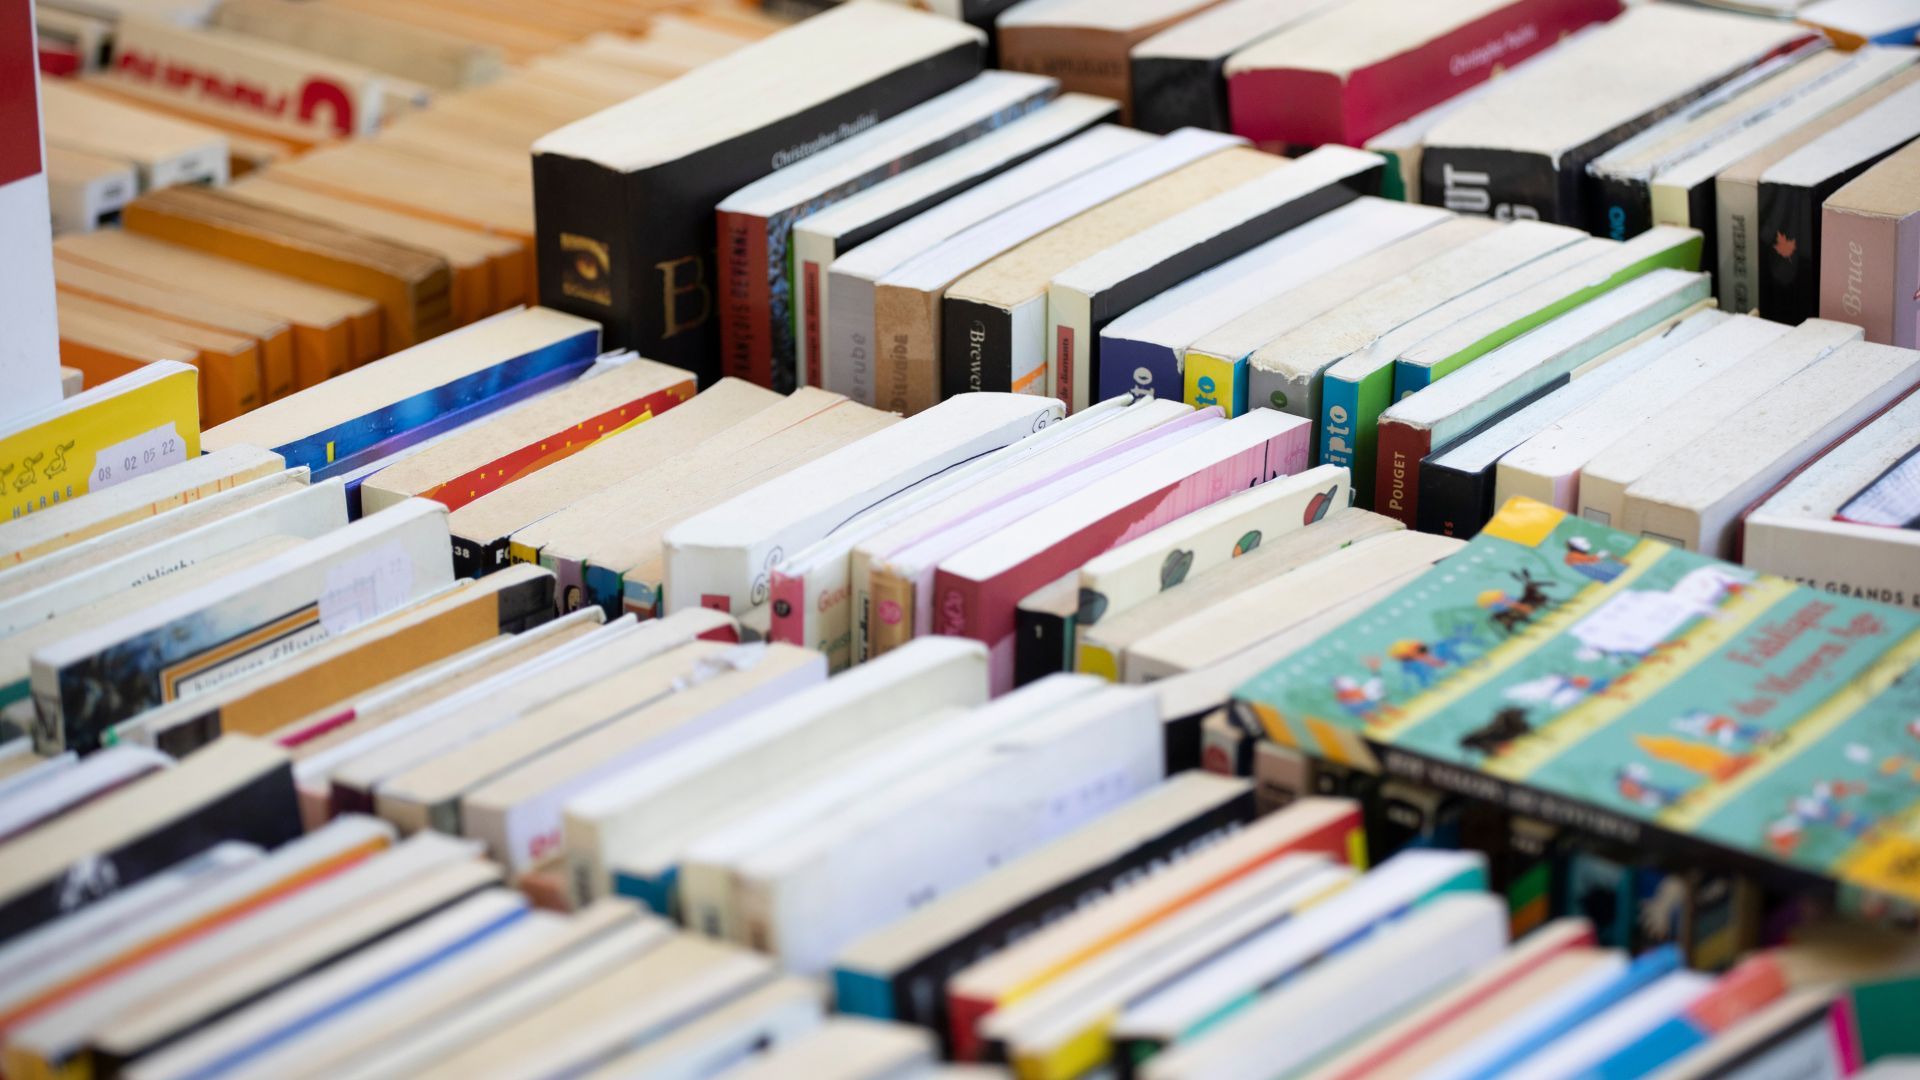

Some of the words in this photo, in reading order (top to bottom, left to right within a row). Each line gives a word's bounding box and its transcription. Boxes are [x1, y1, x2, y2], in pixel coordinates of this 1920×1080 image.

[1443, 163, 1490, 214] UT
[1842, 241, 1863, 317] Bruce
[969, 320, 986, 392] Brewer
[1061, 338, 1070, 384] diamants
[1195, 376, 1217, 407] to
[98, 466, 112, 482] 08
[124, 456, 138, 472] 02
[143, 448, 156, 464] 05
[161, 439, 176, 456] 22
[1389, 451, 1406, 510] POUGET
[12, 485, 73, 519] HERBE
[1825, 581, 1904, 606] GRANDS
